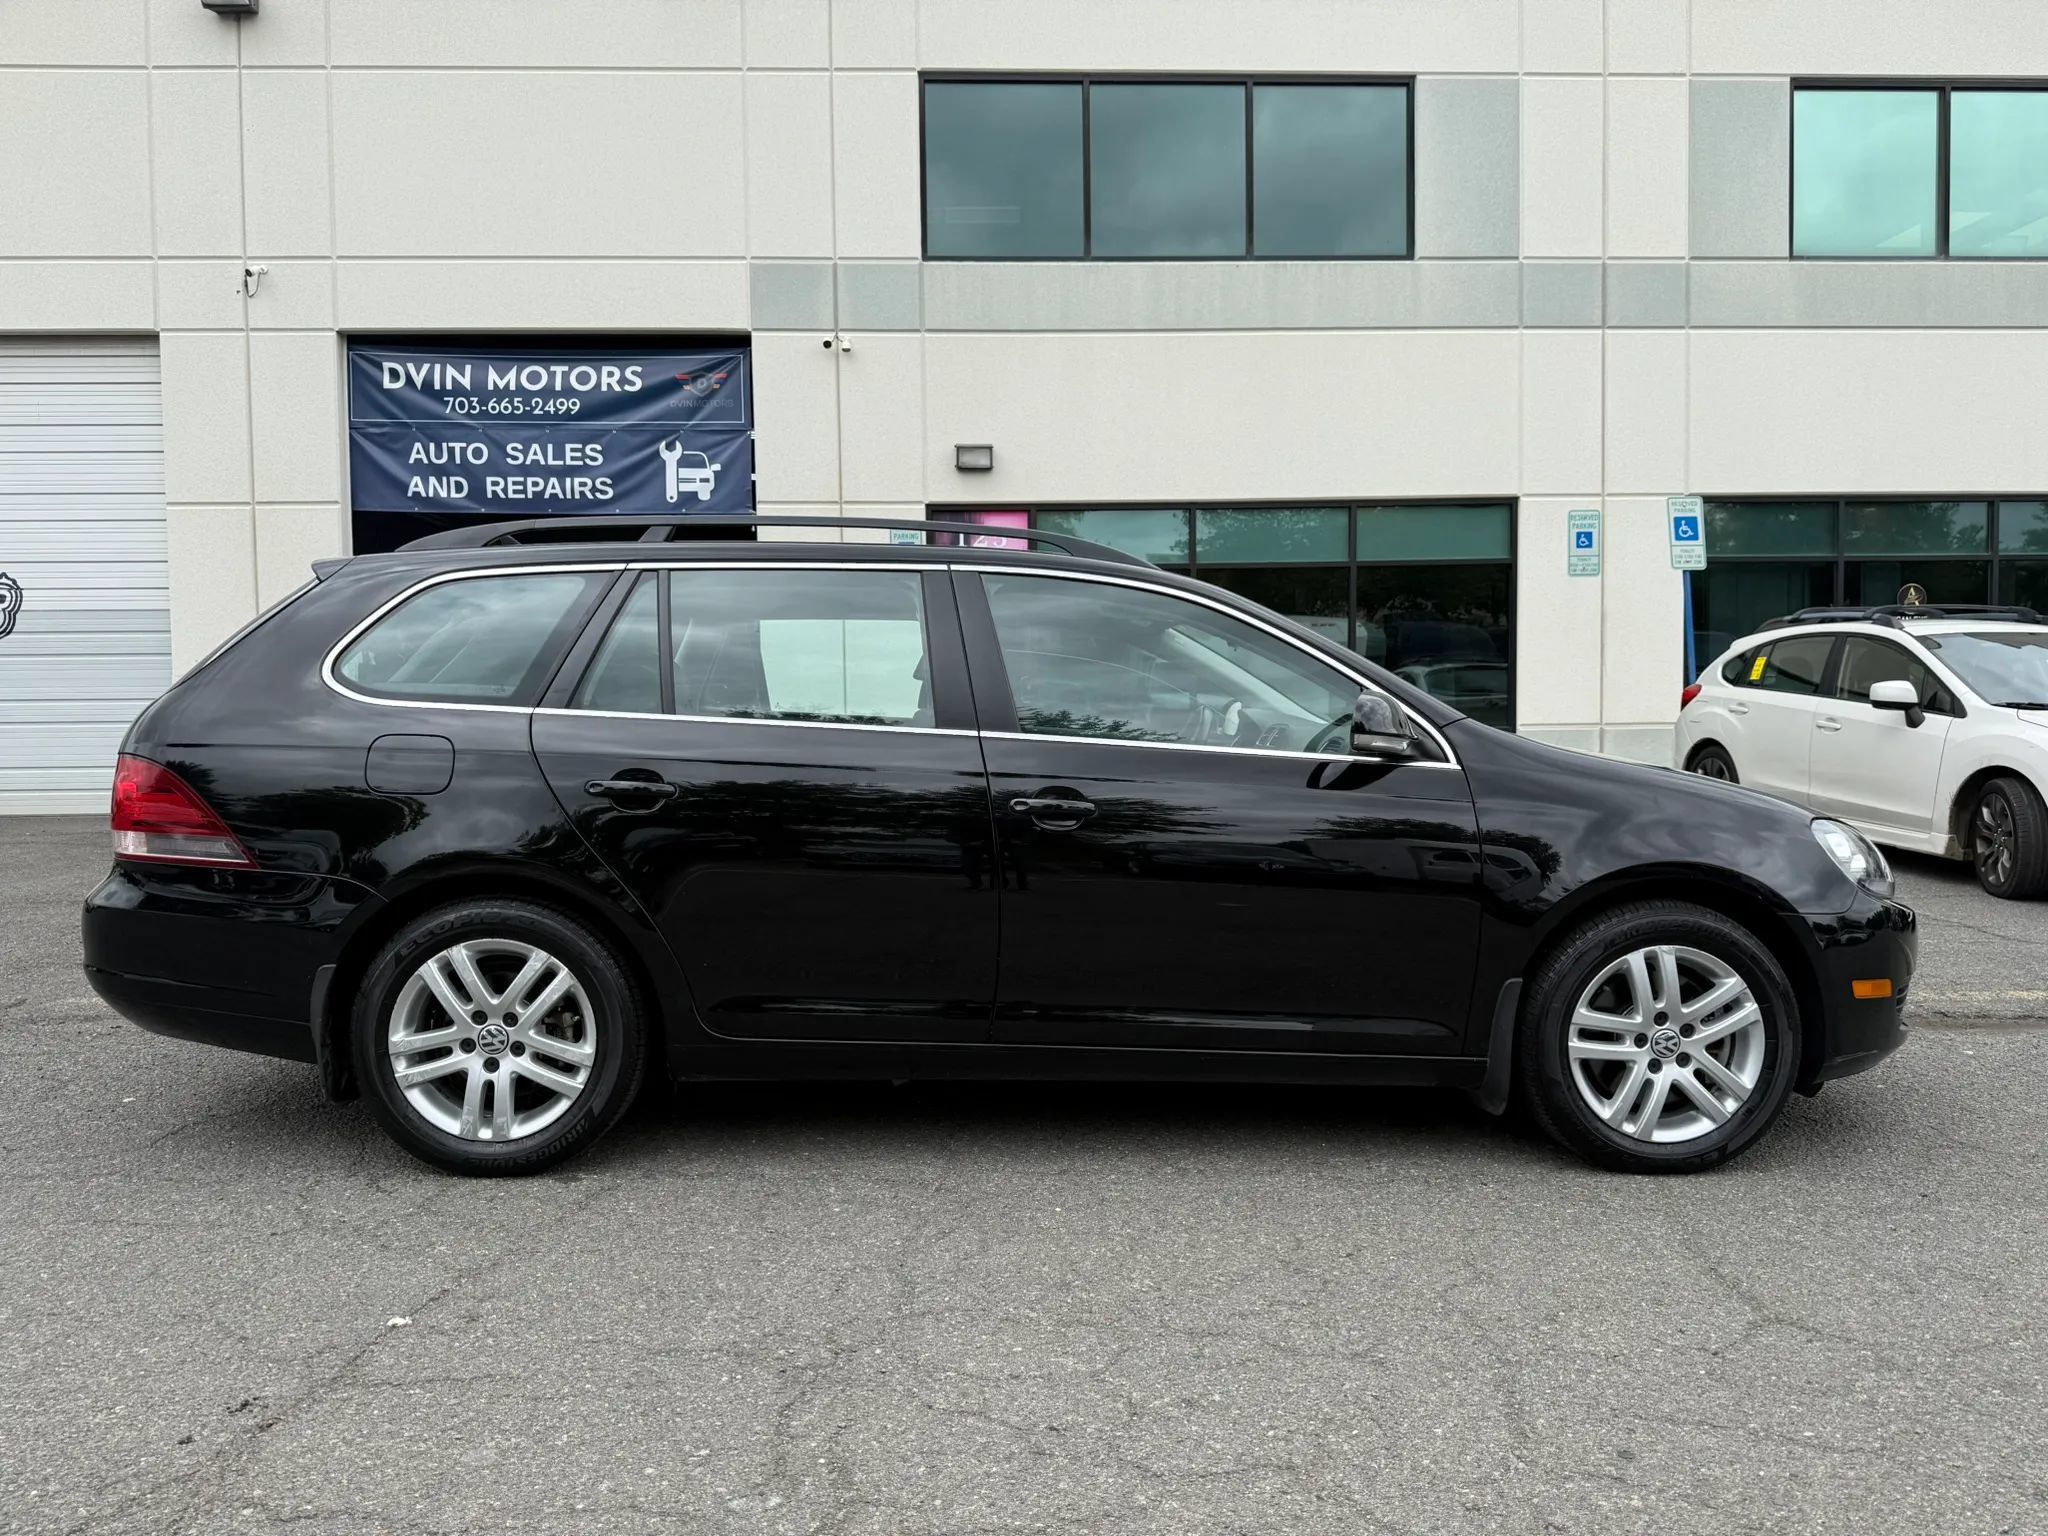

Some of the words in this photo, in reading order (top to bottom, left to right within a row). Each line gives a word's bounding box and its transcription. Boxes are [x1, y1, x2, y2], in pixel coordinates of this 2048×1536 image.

[382, 361, 472, 391] DVIN
[487, 364, 643, 392] MOTORS
[443, 396, 581, 415] 703-665-2499
[408, 442, 489, 465] AUTO
[505, 442, 604, 466] SALES
[407, 475, 469, 499] AND
[485, 476, 614, 500] REPAIRS
[893, 532, 919, 541] PARKING
